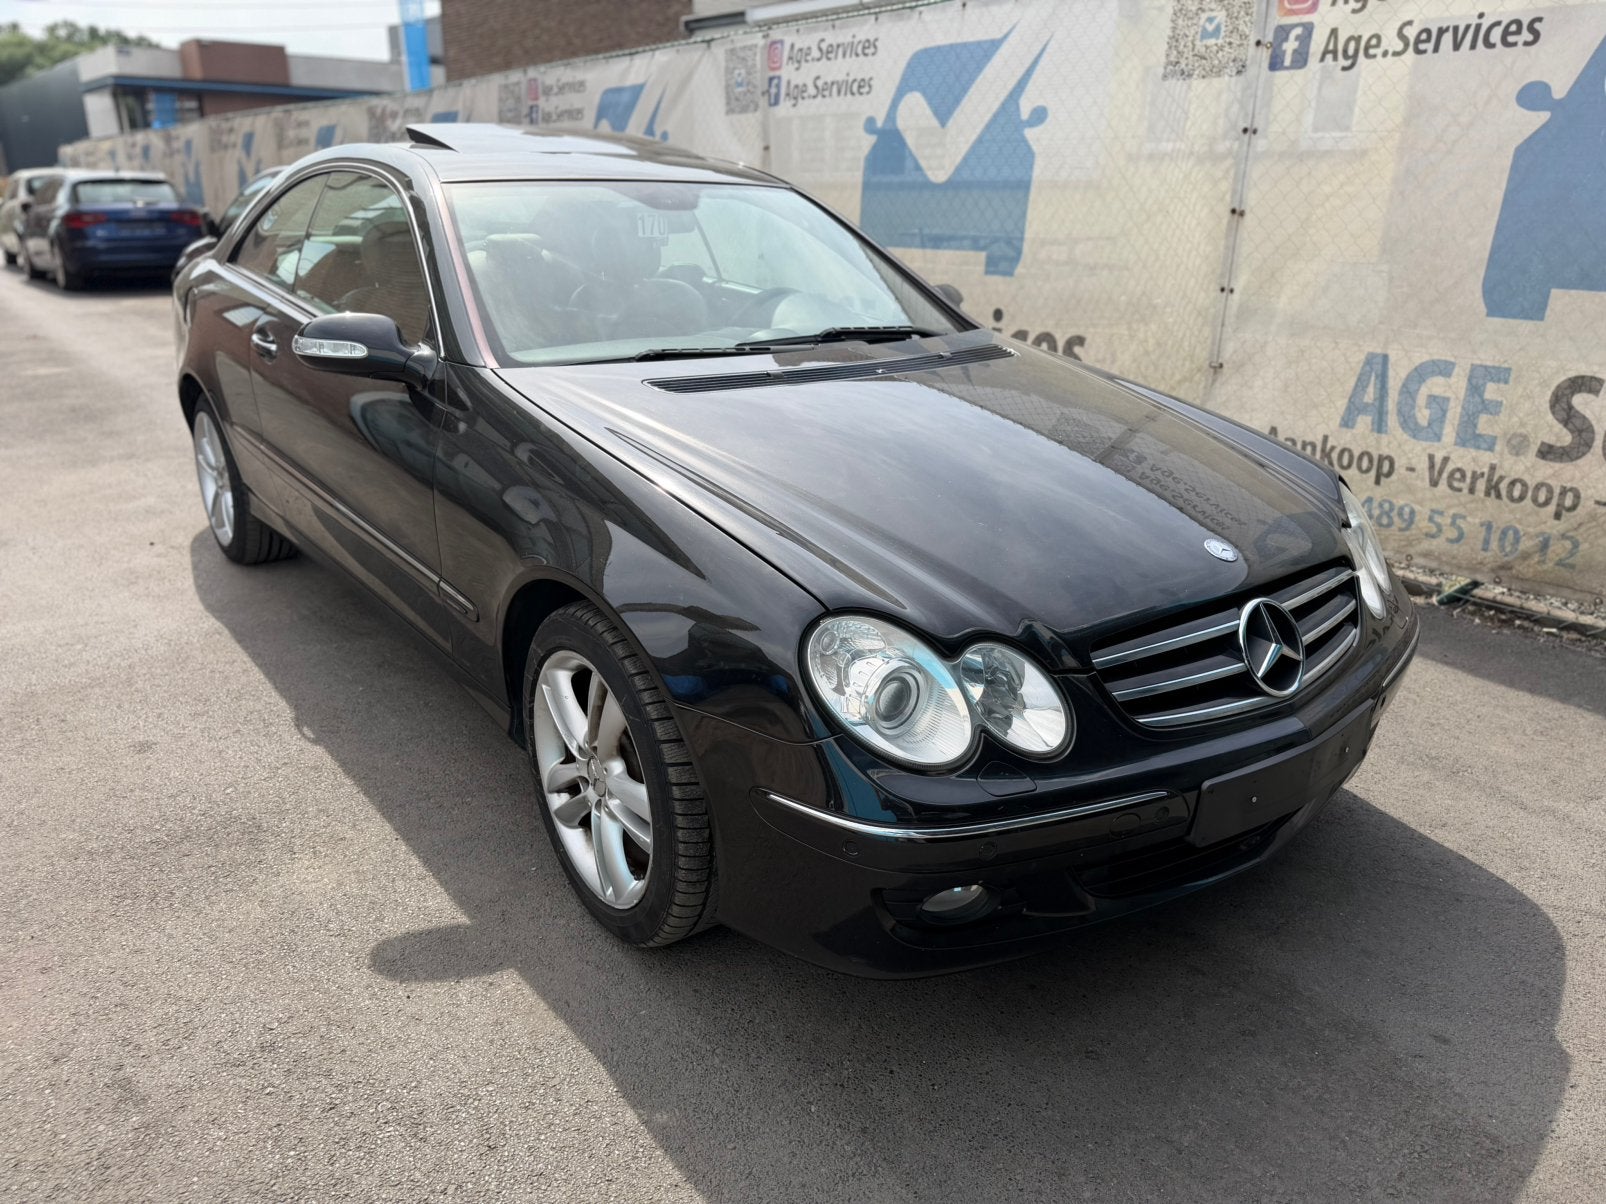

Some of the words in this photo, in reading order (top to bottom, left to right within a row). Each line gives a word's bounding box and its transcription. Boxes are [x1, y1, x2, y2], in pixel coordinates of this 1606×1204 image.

[786, 34, 879, 71] Age.Services
[1319, 12, 1544, 71] Age.Services
[783, 72, 873, 107] Age.Services
[1339, 351, 1606, 464] AGE.S
[1427, 453, 1582, 521] Verkoop
[1424, 508, 1468, 545] 55
[1480, 520, 1522, 560] 10
[1536, 531, 1582, 570] 12
